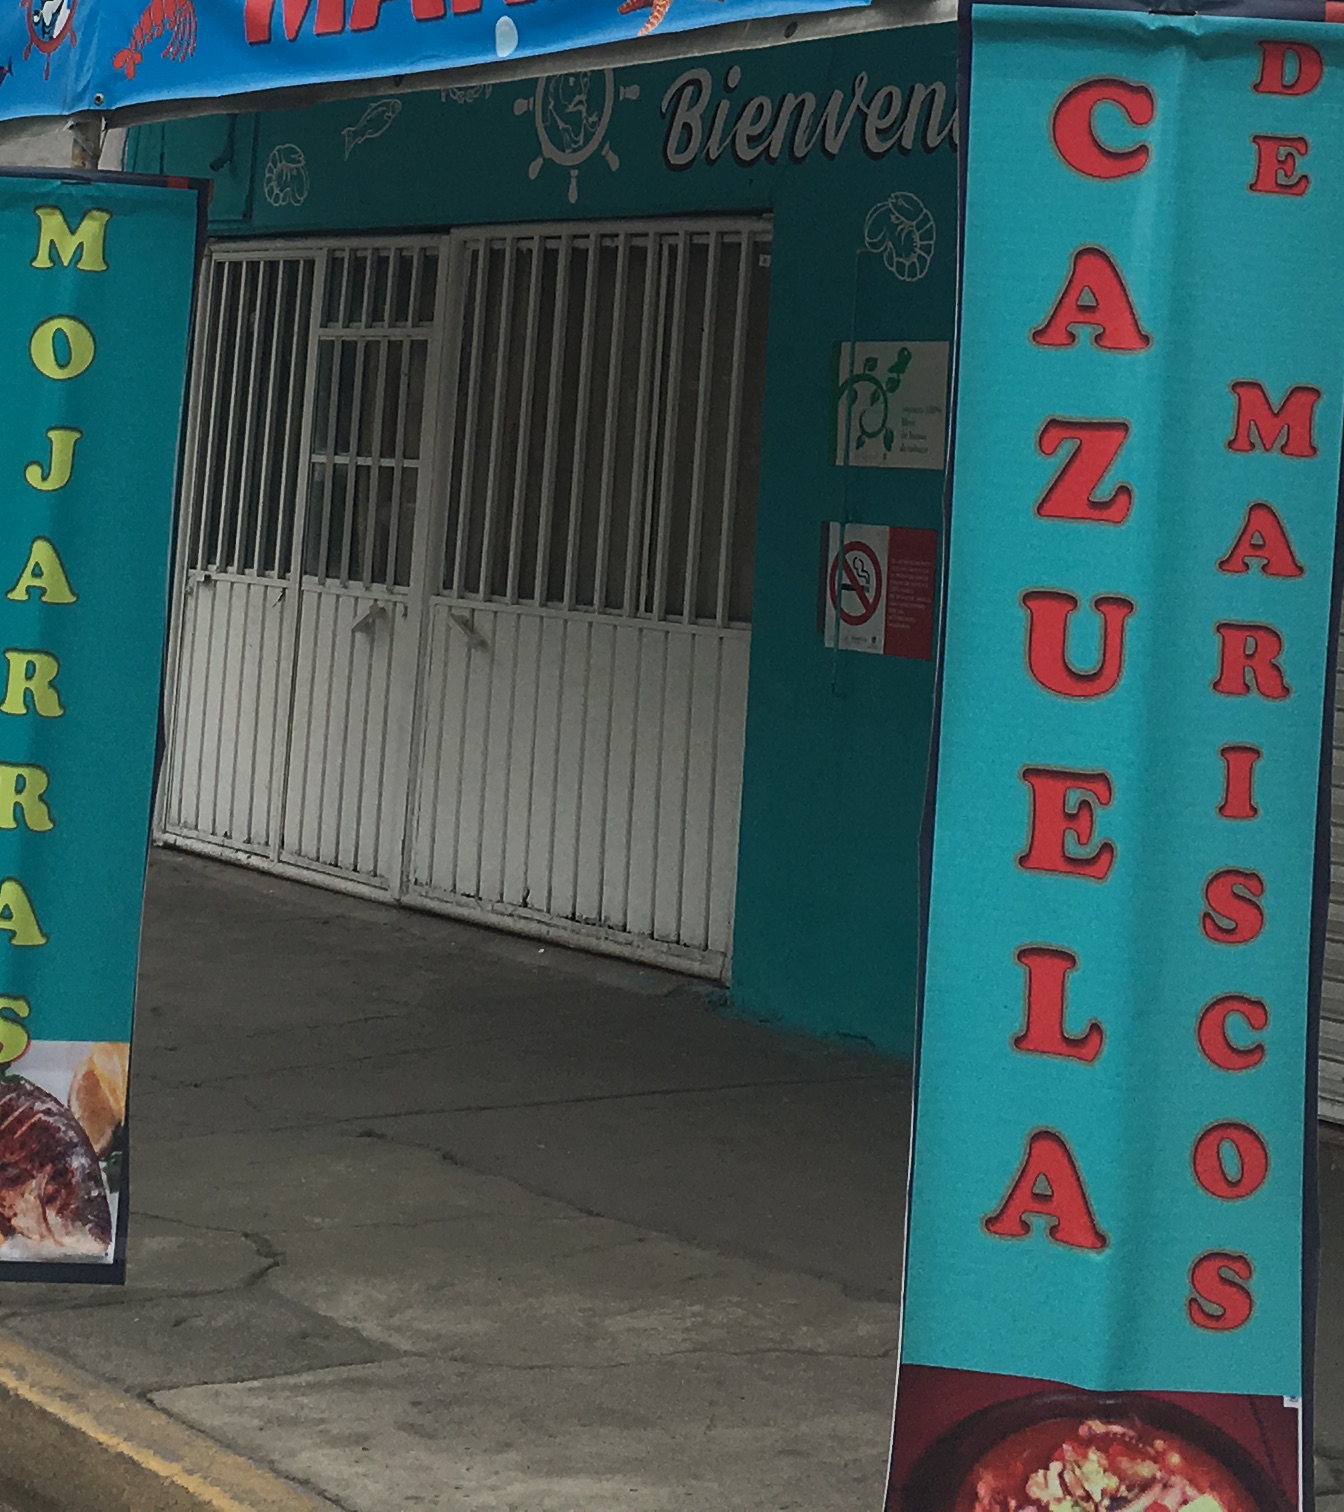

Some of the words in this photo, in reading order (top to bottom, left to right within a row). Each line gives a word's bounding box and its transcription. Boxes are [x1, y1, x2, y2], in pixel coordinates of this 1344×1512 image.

[660, 65, 959, 172] Bienven
[1250, 38, 1325, 197] DE
[983, 76, 1157, 1254] CAZUELA
[1186, 377, 1321, 1335] MARISCOS
